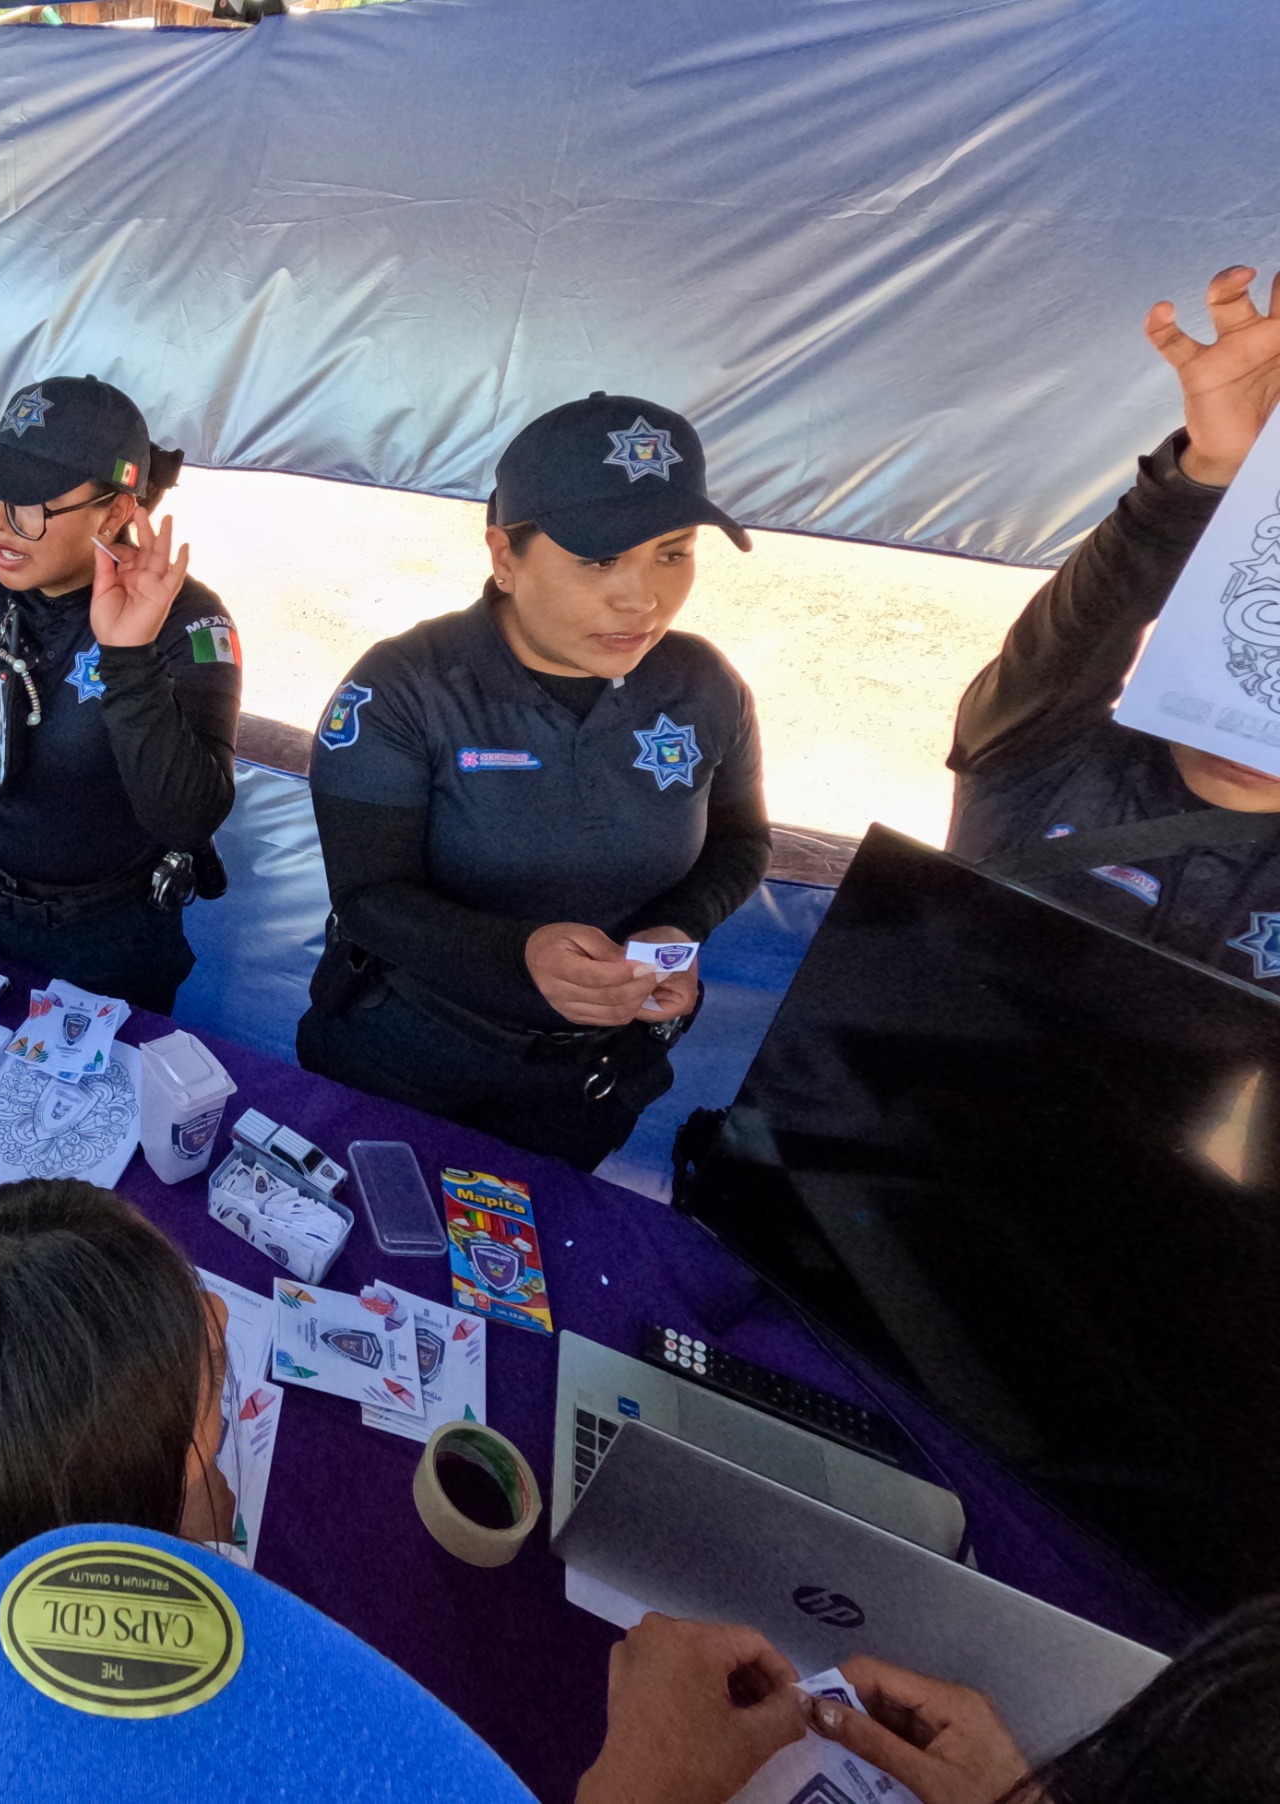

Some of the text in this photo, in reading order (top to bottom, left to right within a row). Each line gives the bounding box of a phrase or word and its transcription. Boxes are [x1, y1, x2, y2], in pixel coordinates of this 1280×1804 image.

[456, 1187, 527, 1215] Mapita
[68, 1571, 170, 1592] PREMIUM & QUALITY
[796, 1588, 862, 1625] hp
[42, 1599, 195, 1649] CAPS GDL
[100, 1661, 125, 1682] THE
